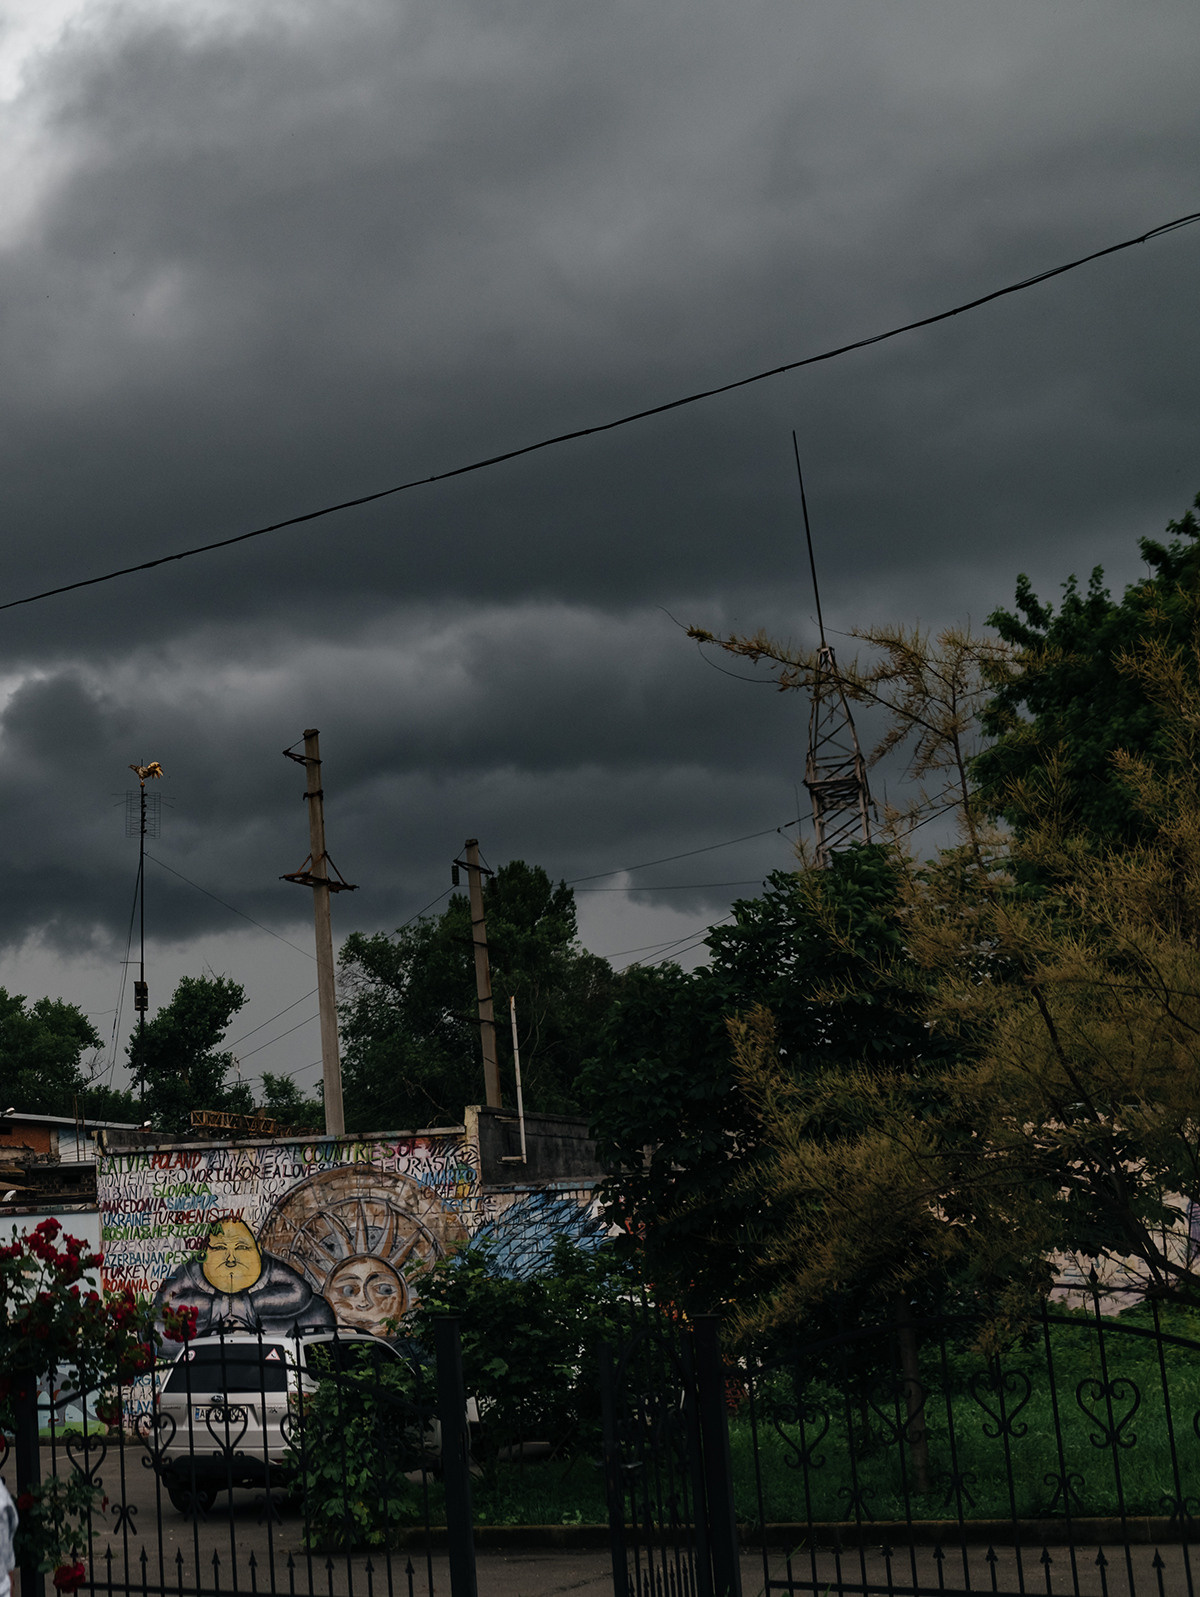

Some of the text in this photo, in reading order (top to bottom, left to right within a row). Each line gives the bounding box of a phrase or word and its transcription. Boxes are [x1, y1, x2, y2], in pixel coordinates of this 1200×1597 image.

[151, 1151, 202, 1169] POLAND
[301, 1140, 395, 1164] COUNTRIES
[383, 1155, 459, 1175] EURASIA
[153, 1182, 212, 1198] SLOVAKIA
[101, 1198, 167, 1214] MAKEDONIA
[103, 1212, 152, 1226] UKRAINE
[103, 1237, 182, 1253] UZBEKISTAN
[103, 1250, 209, 1267] AZERBAIJAN PESTO
[102, 1264, 150, 1280] TURKEY
[102, 1278, 150, 1293] ROMANIA
